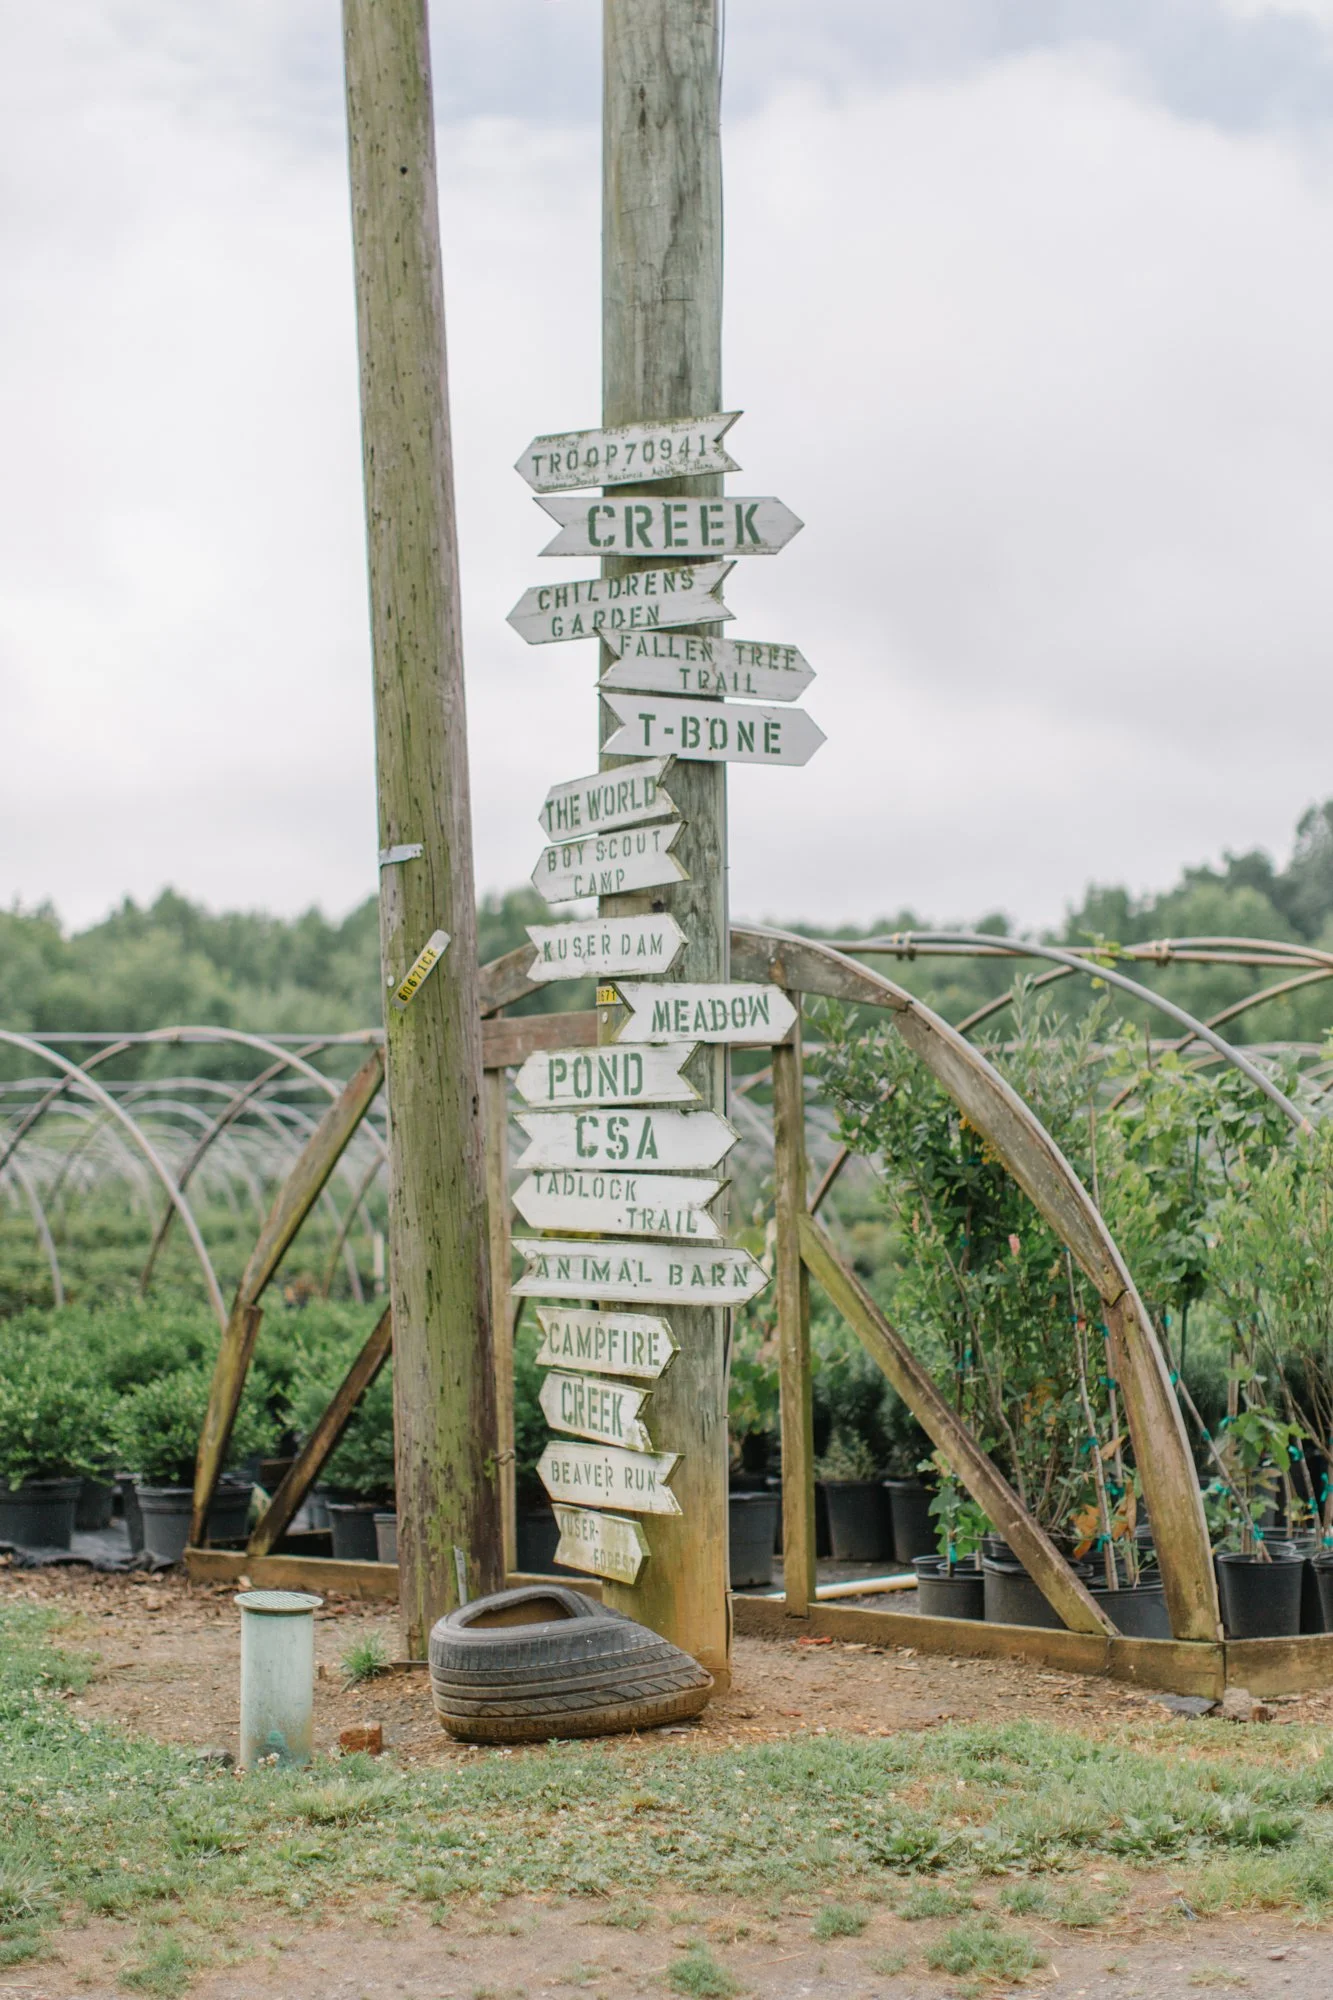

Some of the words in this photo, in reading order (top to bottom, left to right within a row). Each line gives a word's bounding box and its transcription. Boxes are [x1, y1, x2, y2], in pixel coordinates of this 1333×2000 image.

[587, 503, 762, 548] CREEK
[538, 570, 694, 611] CHILDRENS
[552, 605, 660, 637] GARDEN
[619, 634, 714, 662] FALLEN
[734, 644, 797, 671] TREE
[679, 668, 757, 694] TRAIL
[638, 713, 781, 754] T-BONE
[545, 794, 581, 832] THE
[587, 776, 657, 821] WORLD
[547, 843, 584, 872] BOY
[596, 831, 660, 862] SCOUT
[574, 869, 625, 896] CAMP
[543, 934, 611, 962] KUSER
[621, 934, 663, 956] DAM
[652, 994, 770, 1033] MEADOW
[549, 1053, 643, 1100] POND
[576, 1115, 658, 1160] CSA
[533, 1169, 636, 1201] TADLOCK
[626, 1208, 698, 1233] TRAIL
[535, 1254, 652, 1283] ANIMAL
[669, 1263, 749, 1287] BARN
[549, 1322, 660, 1366] CAMPFIRE
[560, 1381, 623, 1438] CREEK
[551, 1460, 613, 1489] BEAVER
[624, 1472, 656, 1493] RUN
